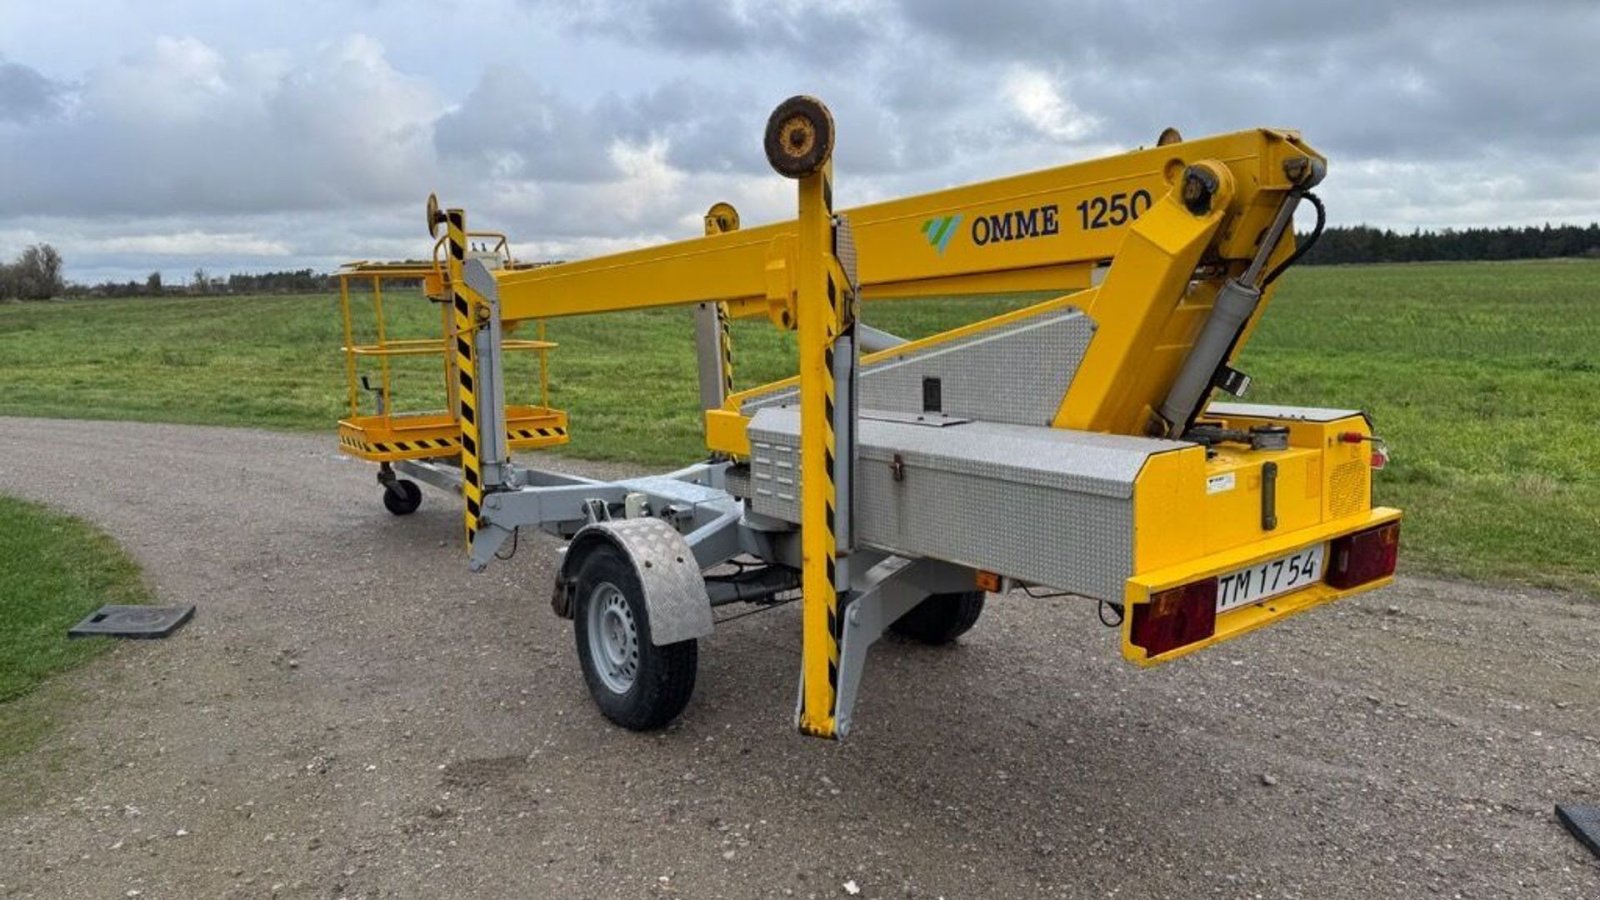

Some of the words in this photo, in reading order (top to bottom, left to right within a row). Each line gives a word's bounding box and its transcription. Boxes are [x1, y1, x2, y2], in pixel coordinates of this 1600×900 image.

[972, 205, 1059, 246] OMME
[1077, 189, 1152, 230] 1250
[1220, 569, 1251, 606] TM
